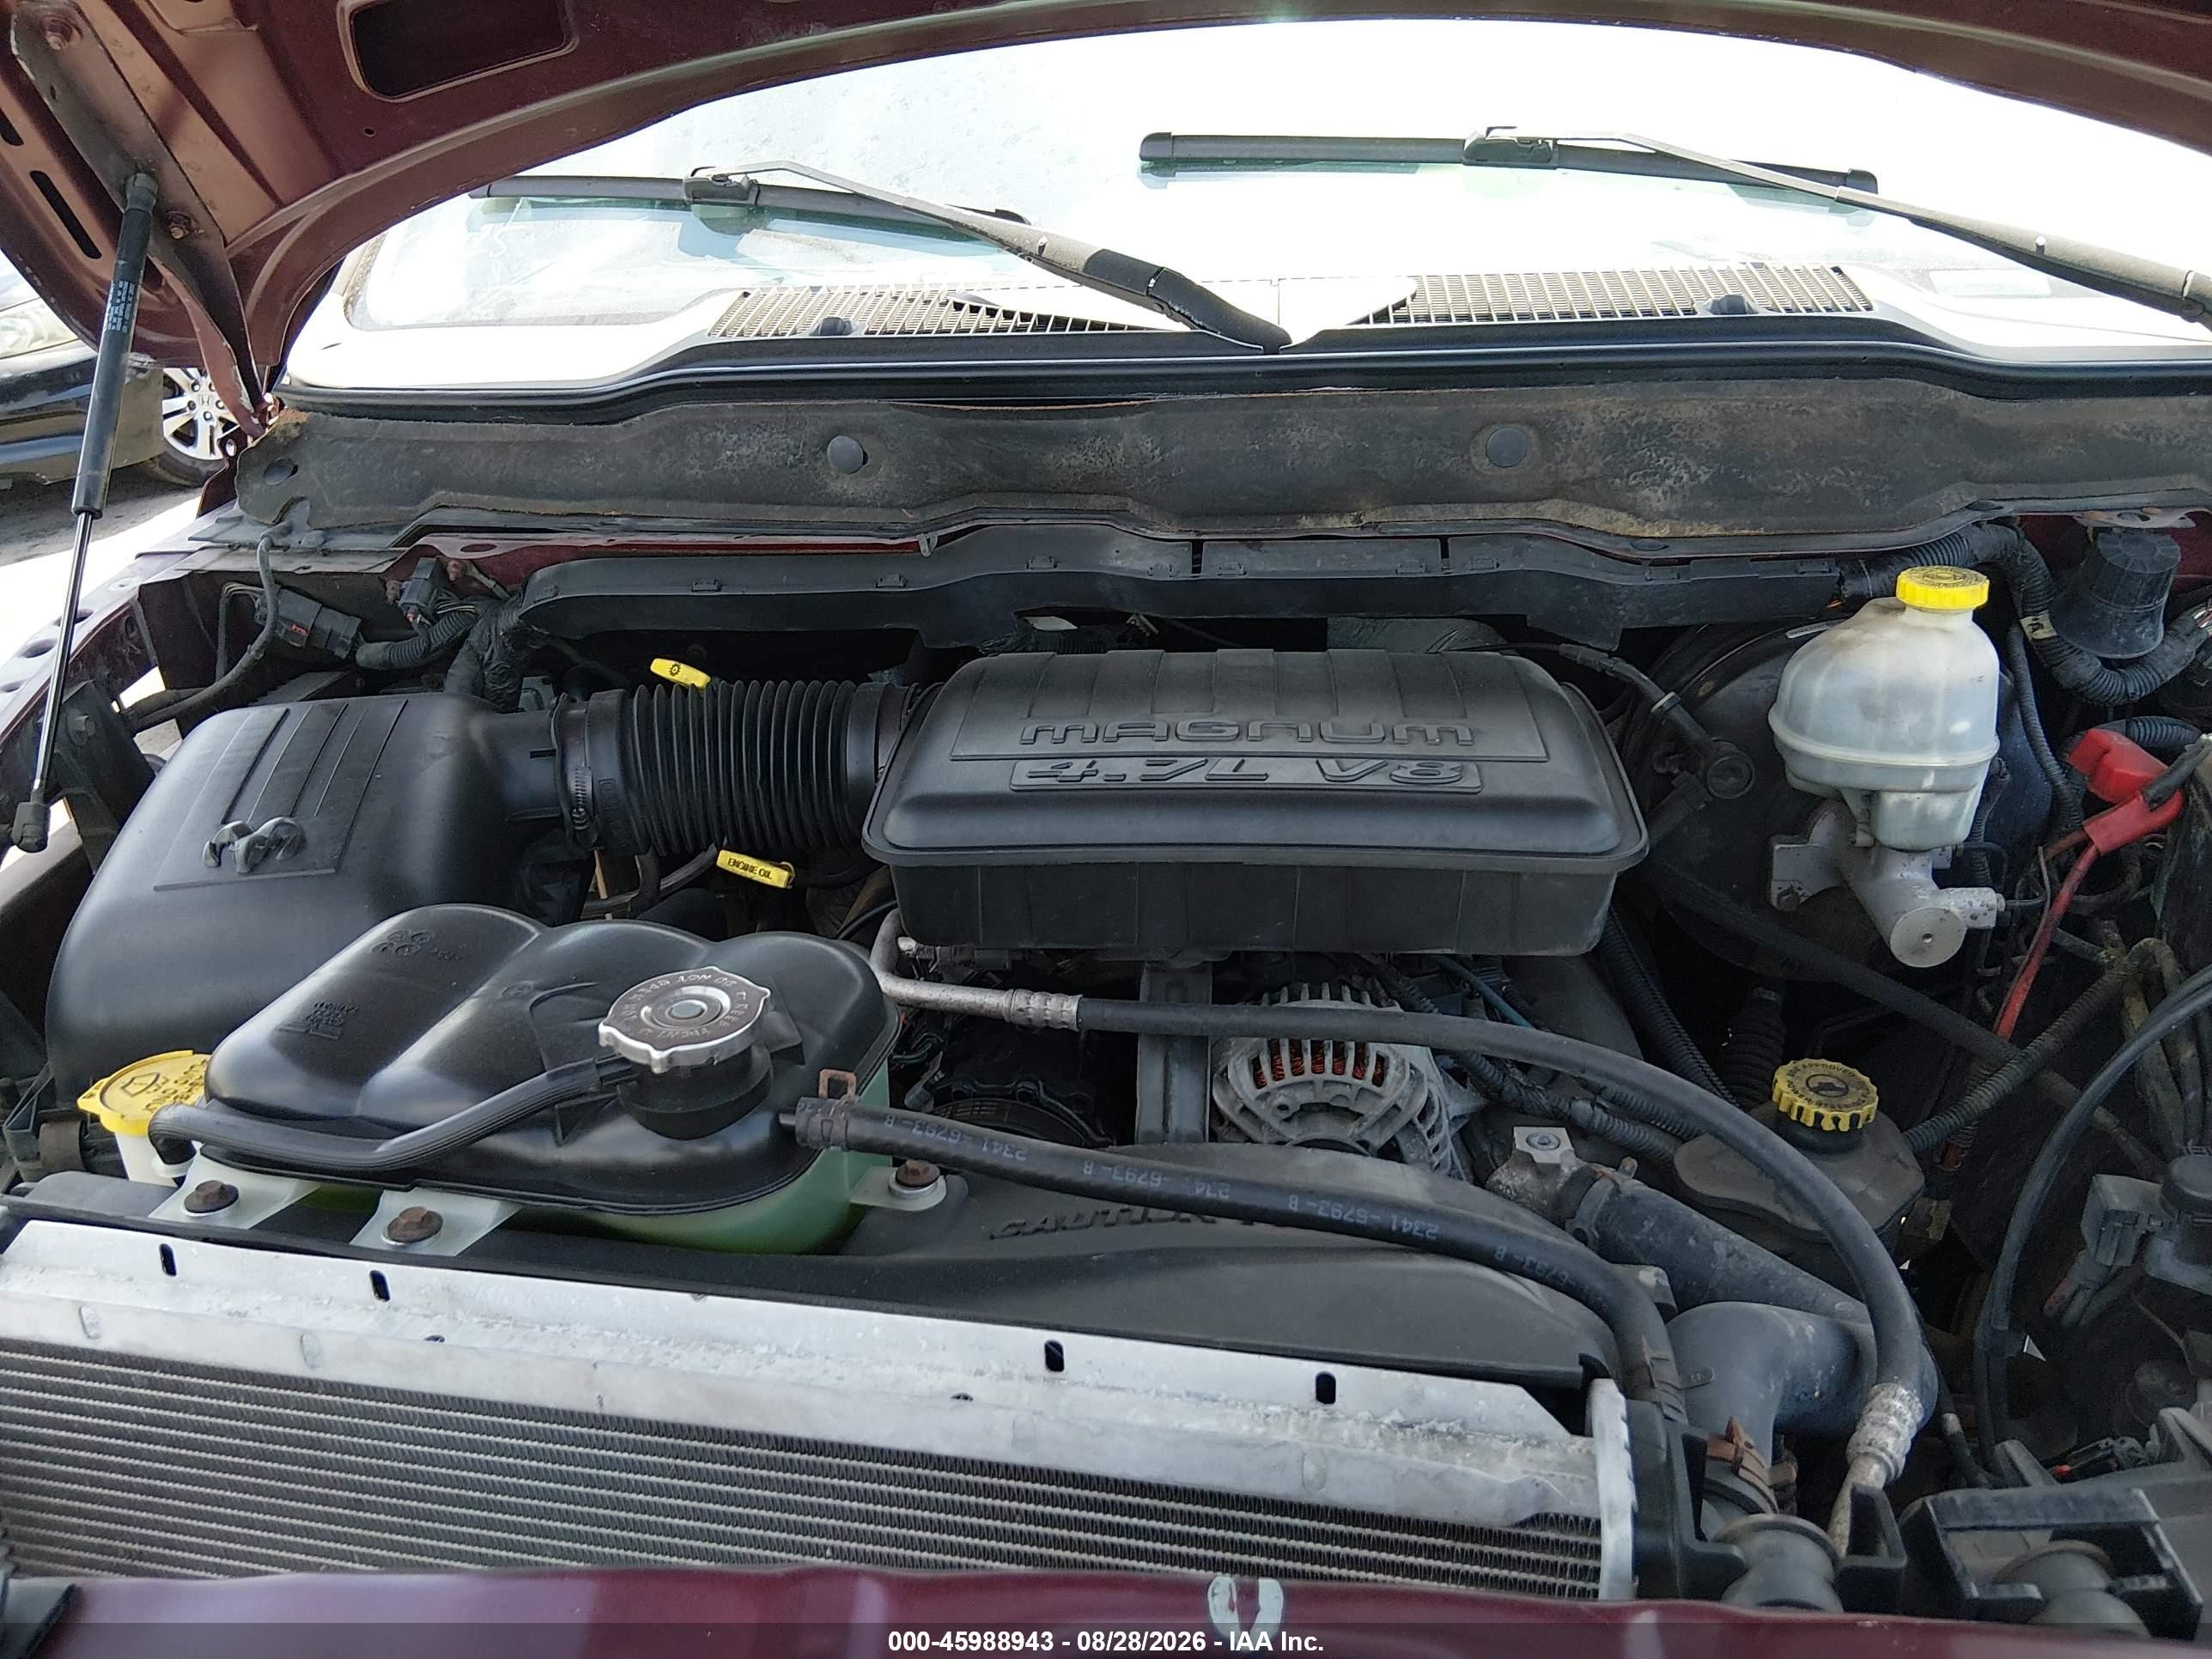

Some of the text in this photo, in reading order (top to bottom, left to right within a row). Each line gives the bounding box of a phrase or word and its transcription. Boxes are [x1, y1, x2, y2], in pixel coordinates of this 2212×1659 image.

[1027, 757, 1463, 785] 4.7L V8
[728, 858, 773, 879] ENGINE OIL
